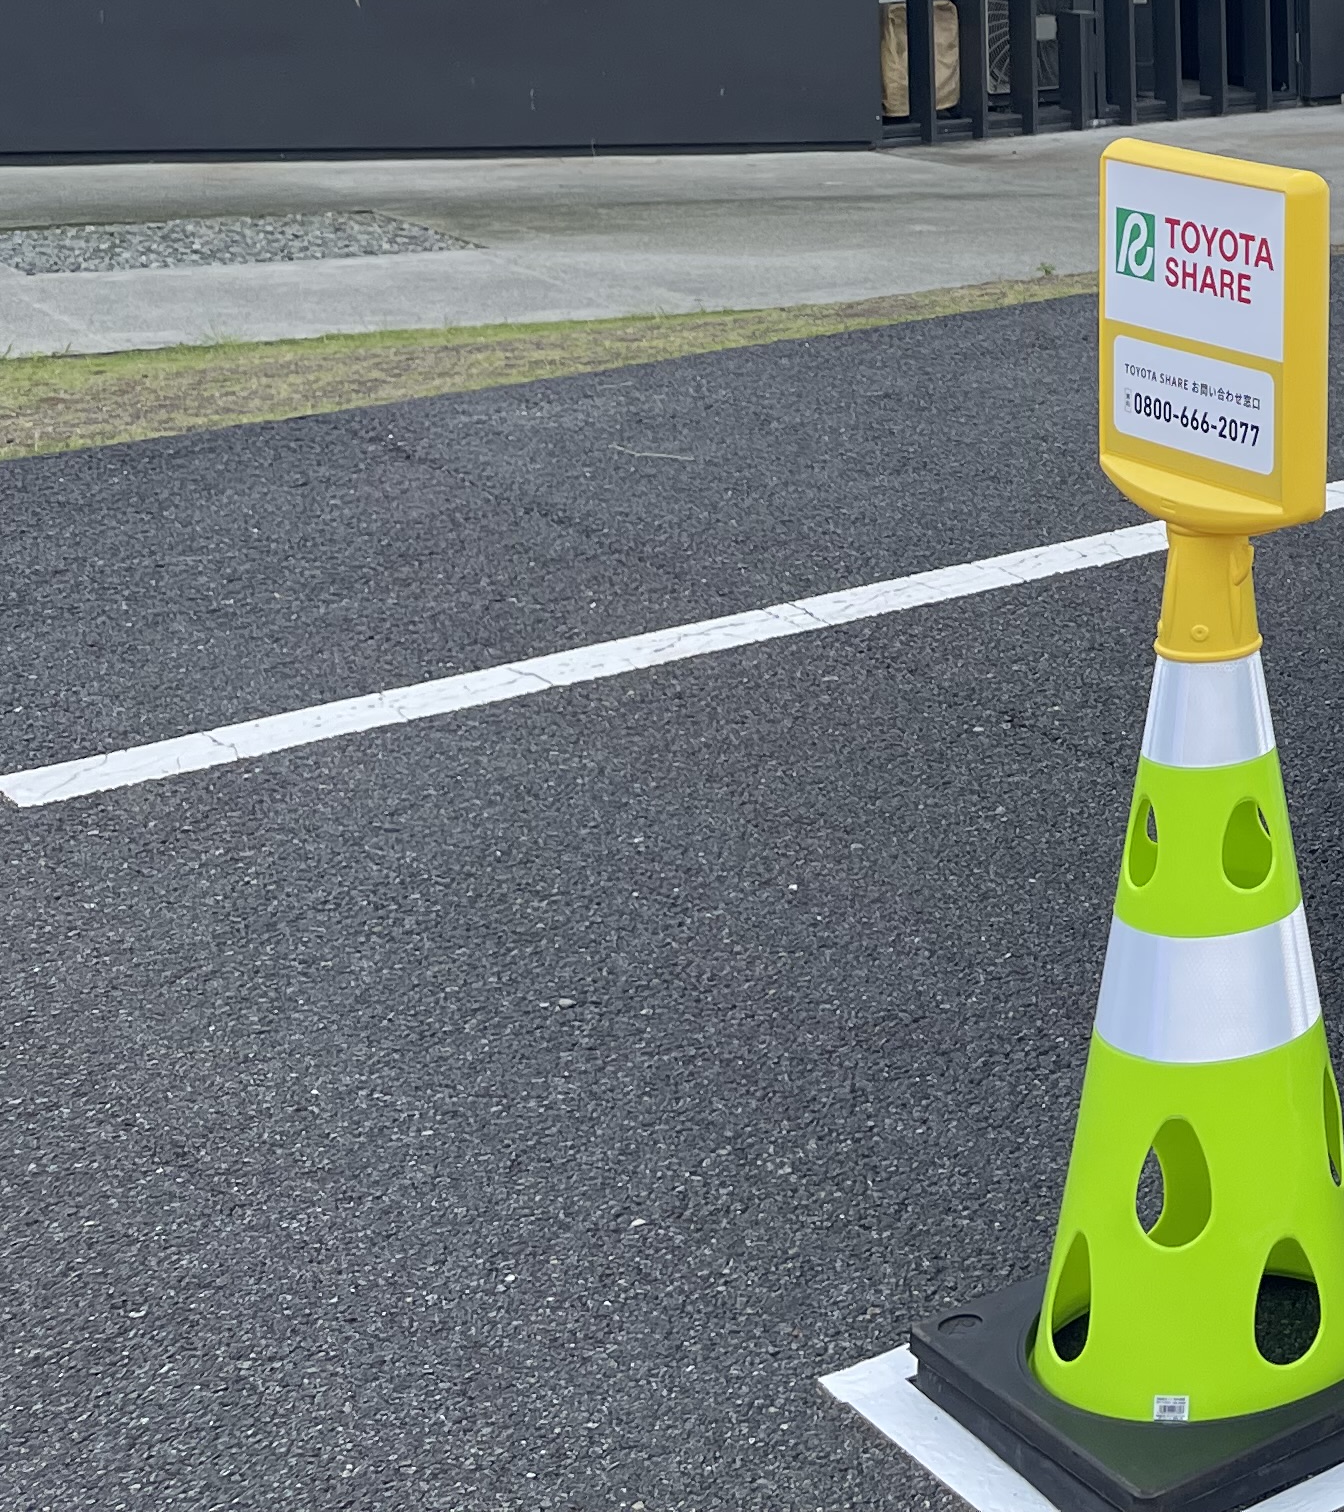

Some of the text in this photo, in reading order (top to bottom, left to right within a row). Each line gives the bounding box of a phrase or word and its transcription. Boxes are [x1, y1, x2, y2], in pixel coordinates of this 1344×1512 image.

[1164, 217, 1274, 271] TOYOTA
[1165, 256, 1252, 305] SHARE
[1124, 363, 1261, 411] TOYOTA SHARE お問い合わせ窓口
[1134, 392, 1260, 447] 0800-666-2077
